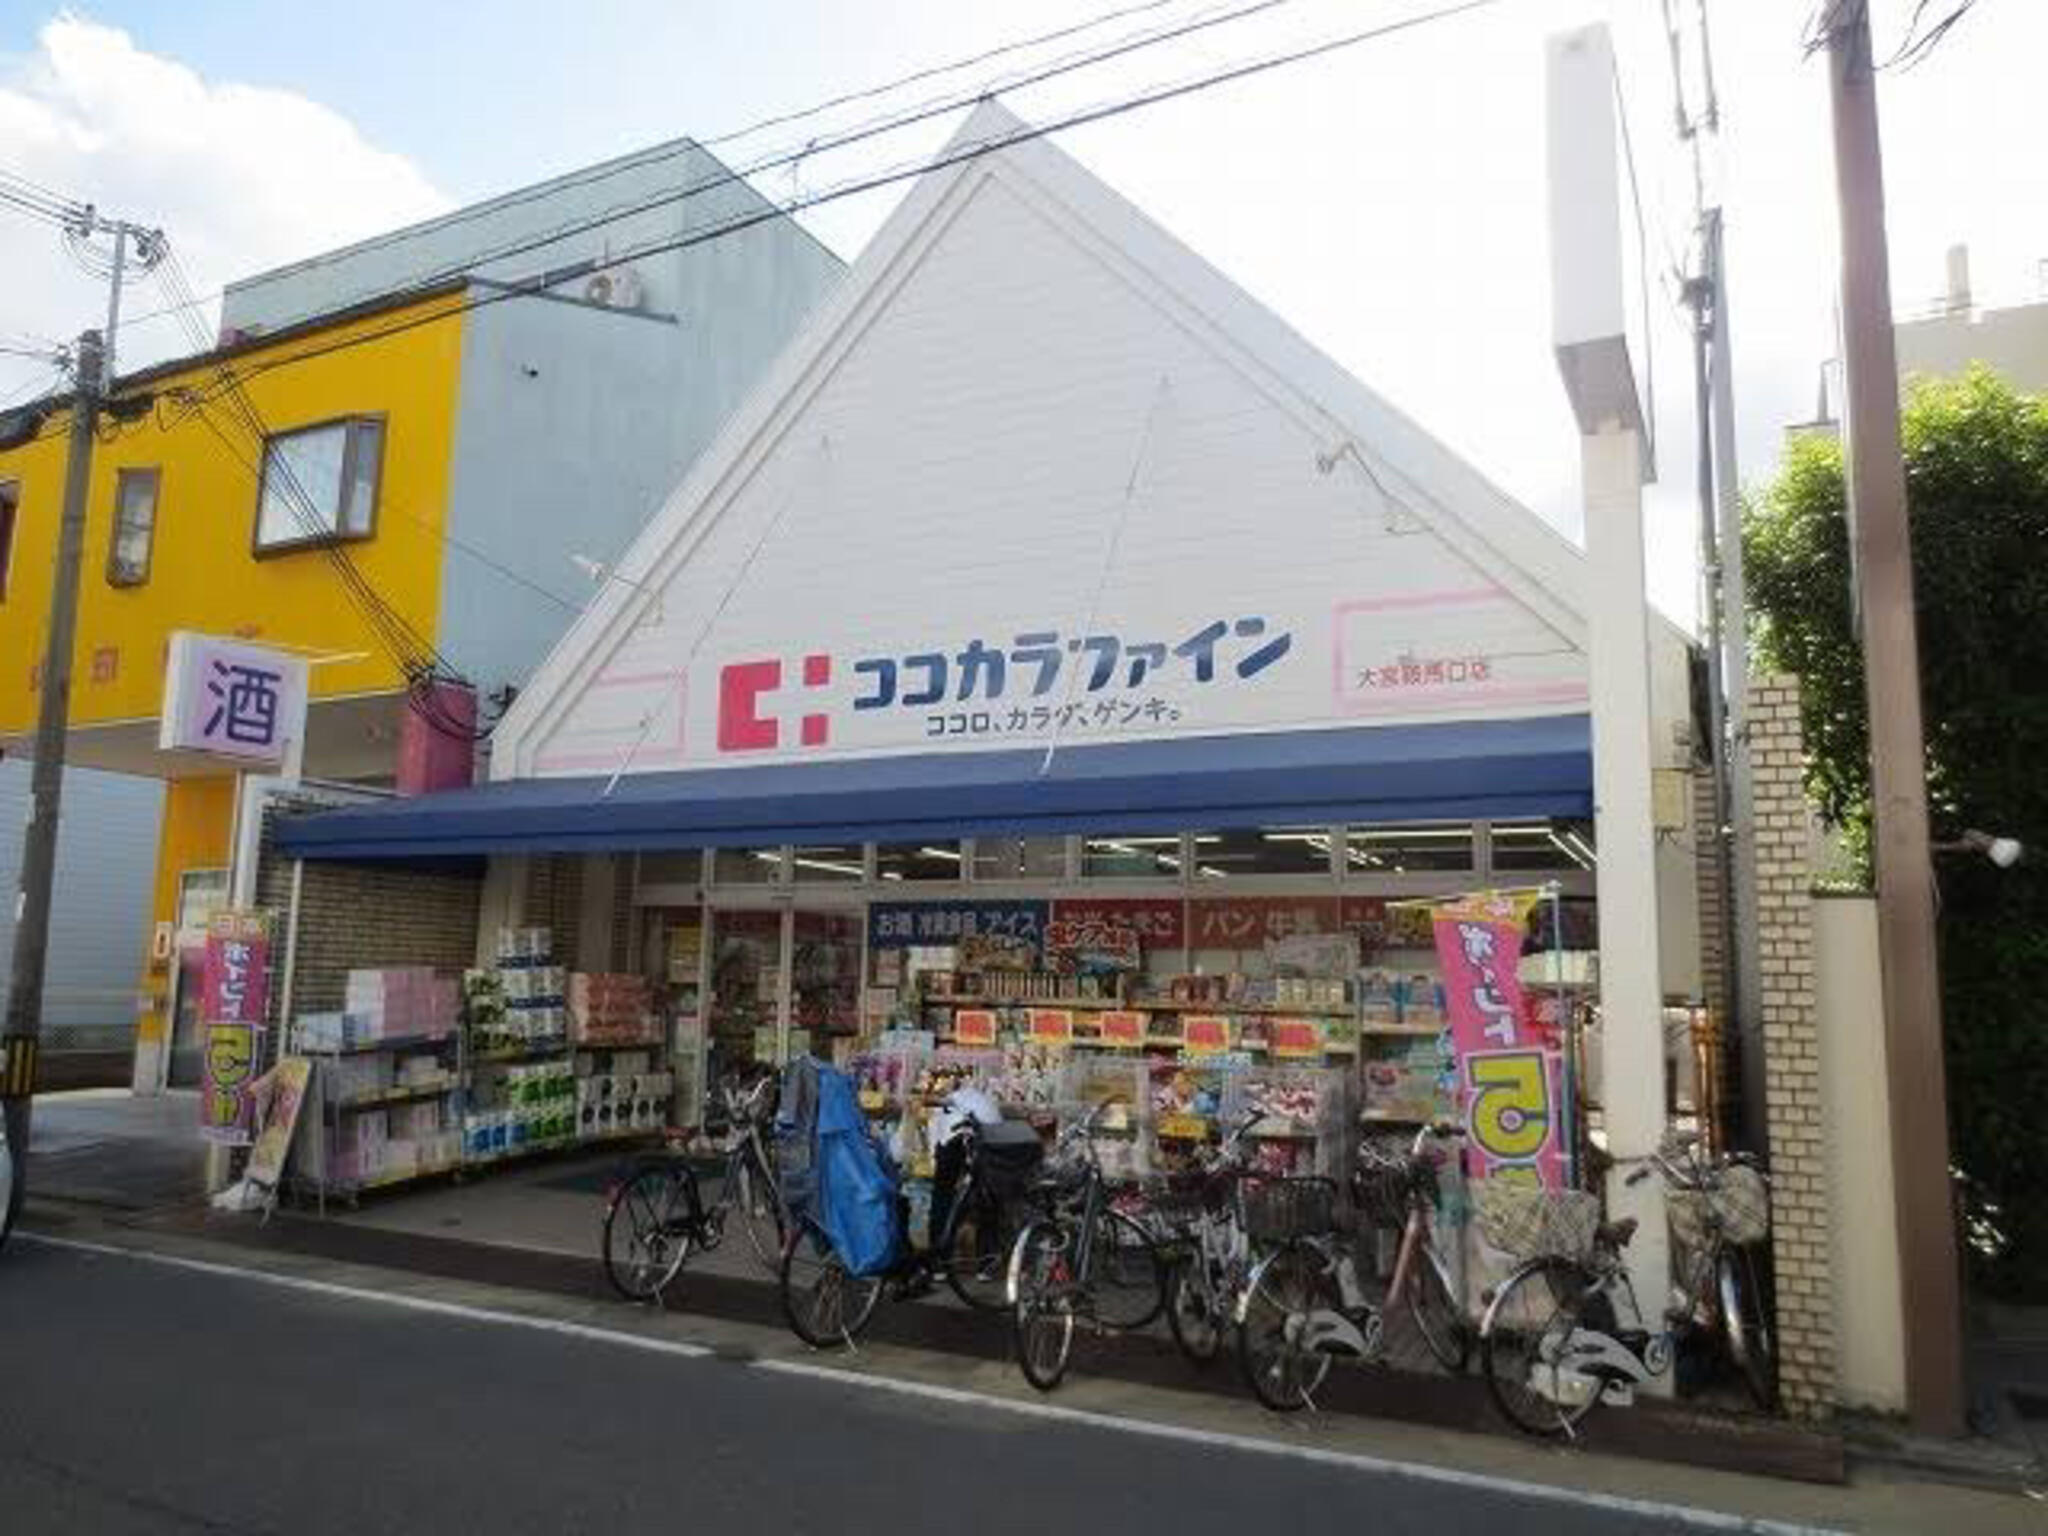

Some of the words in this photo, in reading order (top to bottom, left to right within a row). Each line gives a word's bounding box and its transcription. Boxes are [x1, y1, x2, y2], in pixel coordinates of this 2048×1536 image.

[204, 660, 282, 747] 酒
[853, 616, 1292, 711] ココカラファイン
[1201, 909, 1257, 937] パン
